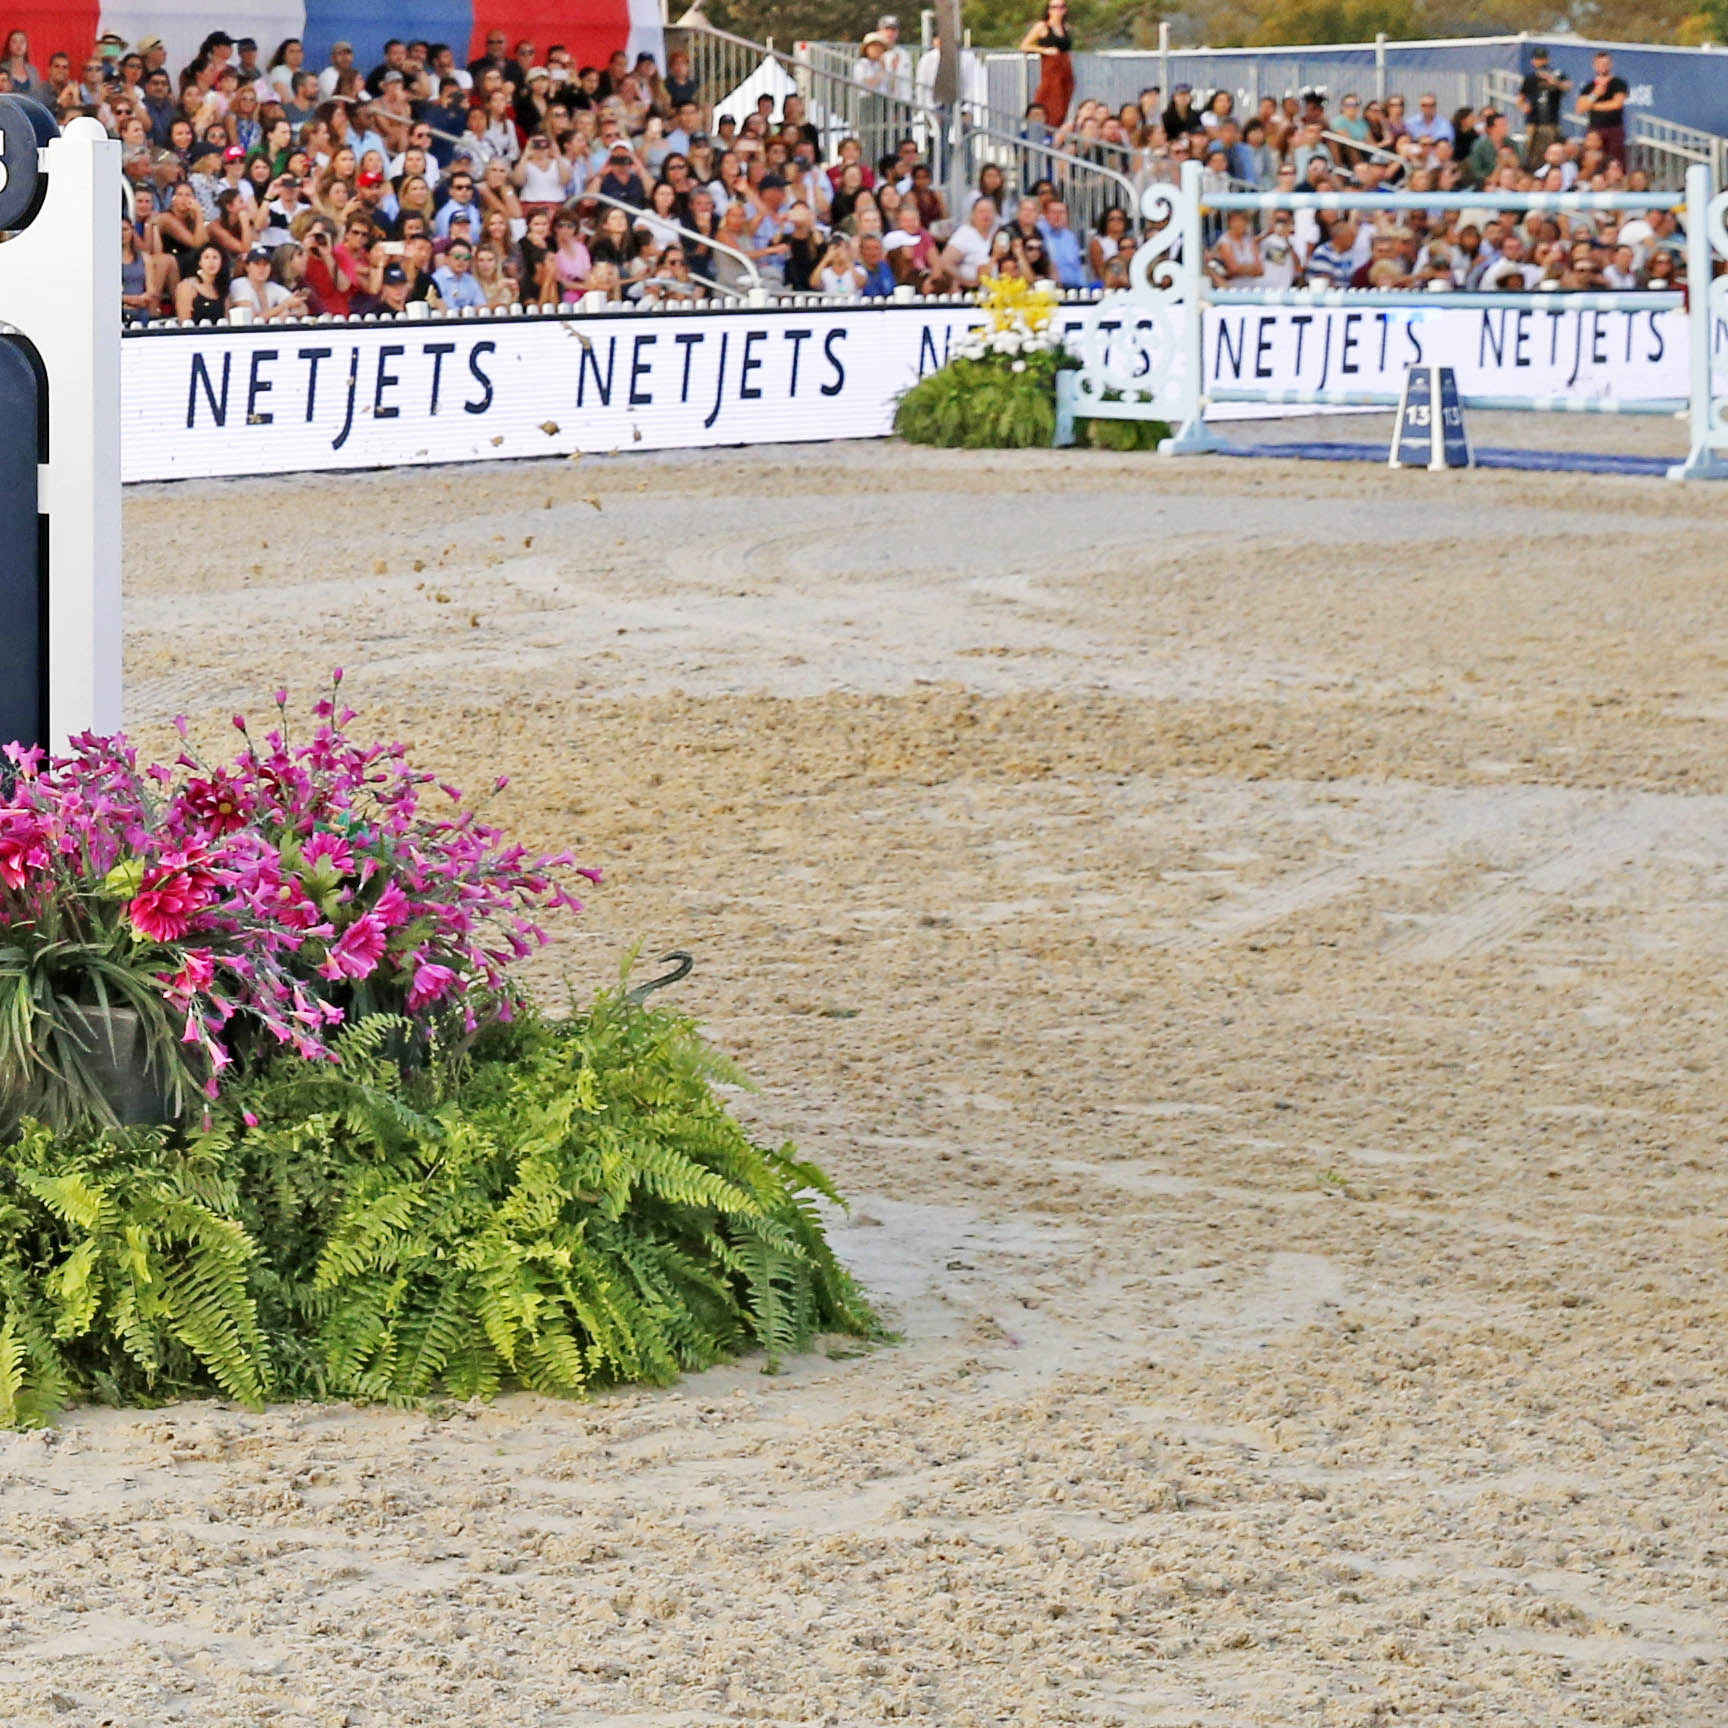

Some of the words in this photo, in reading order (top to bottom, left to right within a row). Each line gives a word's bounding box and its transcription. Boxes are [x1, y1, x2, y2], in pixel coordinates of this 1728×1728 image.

[577, 328, 848, 429] NETJETS
[1216, 313, 1422, 390] NETJETS
[1479, 309, 1664, 386] NETJETS
[186, 340, 496, 450] NETJETS
[1406, 405, 1430, 426] 13
